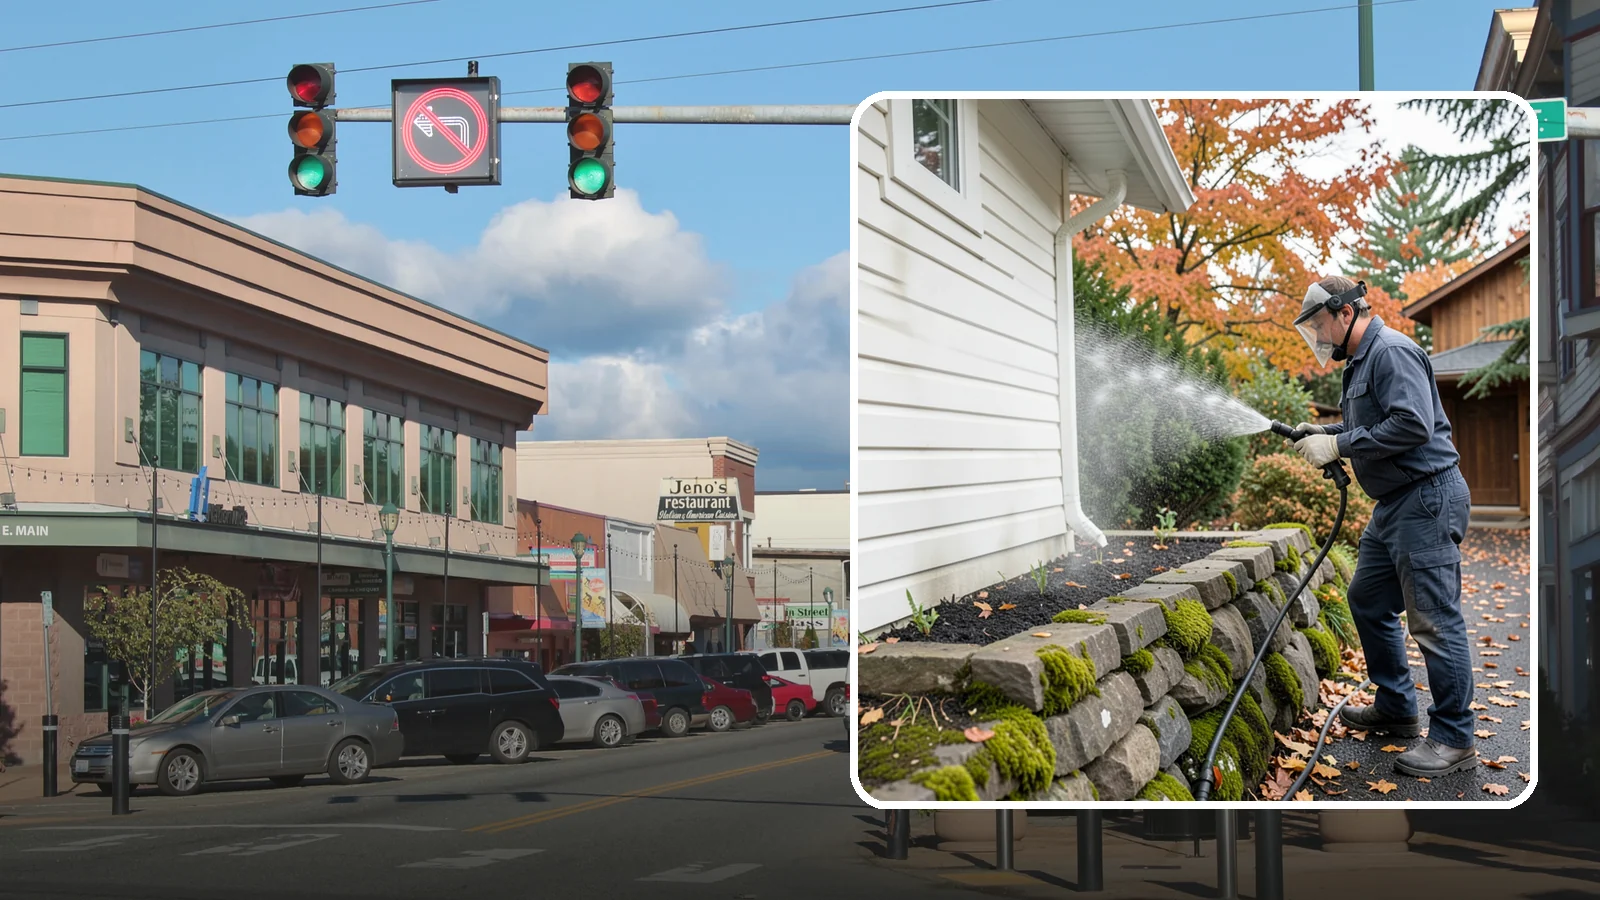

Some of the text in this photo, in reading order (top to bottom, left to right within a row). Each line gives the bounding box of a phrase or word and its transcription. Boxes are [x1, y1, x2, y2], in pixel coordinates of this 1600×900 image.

[669, 480, 727, 495] Jeno's
[665, 496, 730, 509] restaurant
[658, 509, 682, 520] Italian
[686, 509, 715, 520] American
[715, 509, 738, 520] Cuisine
[2, 525, 49, 536] E. MAIN
[797, 607, 829, 617] Street
